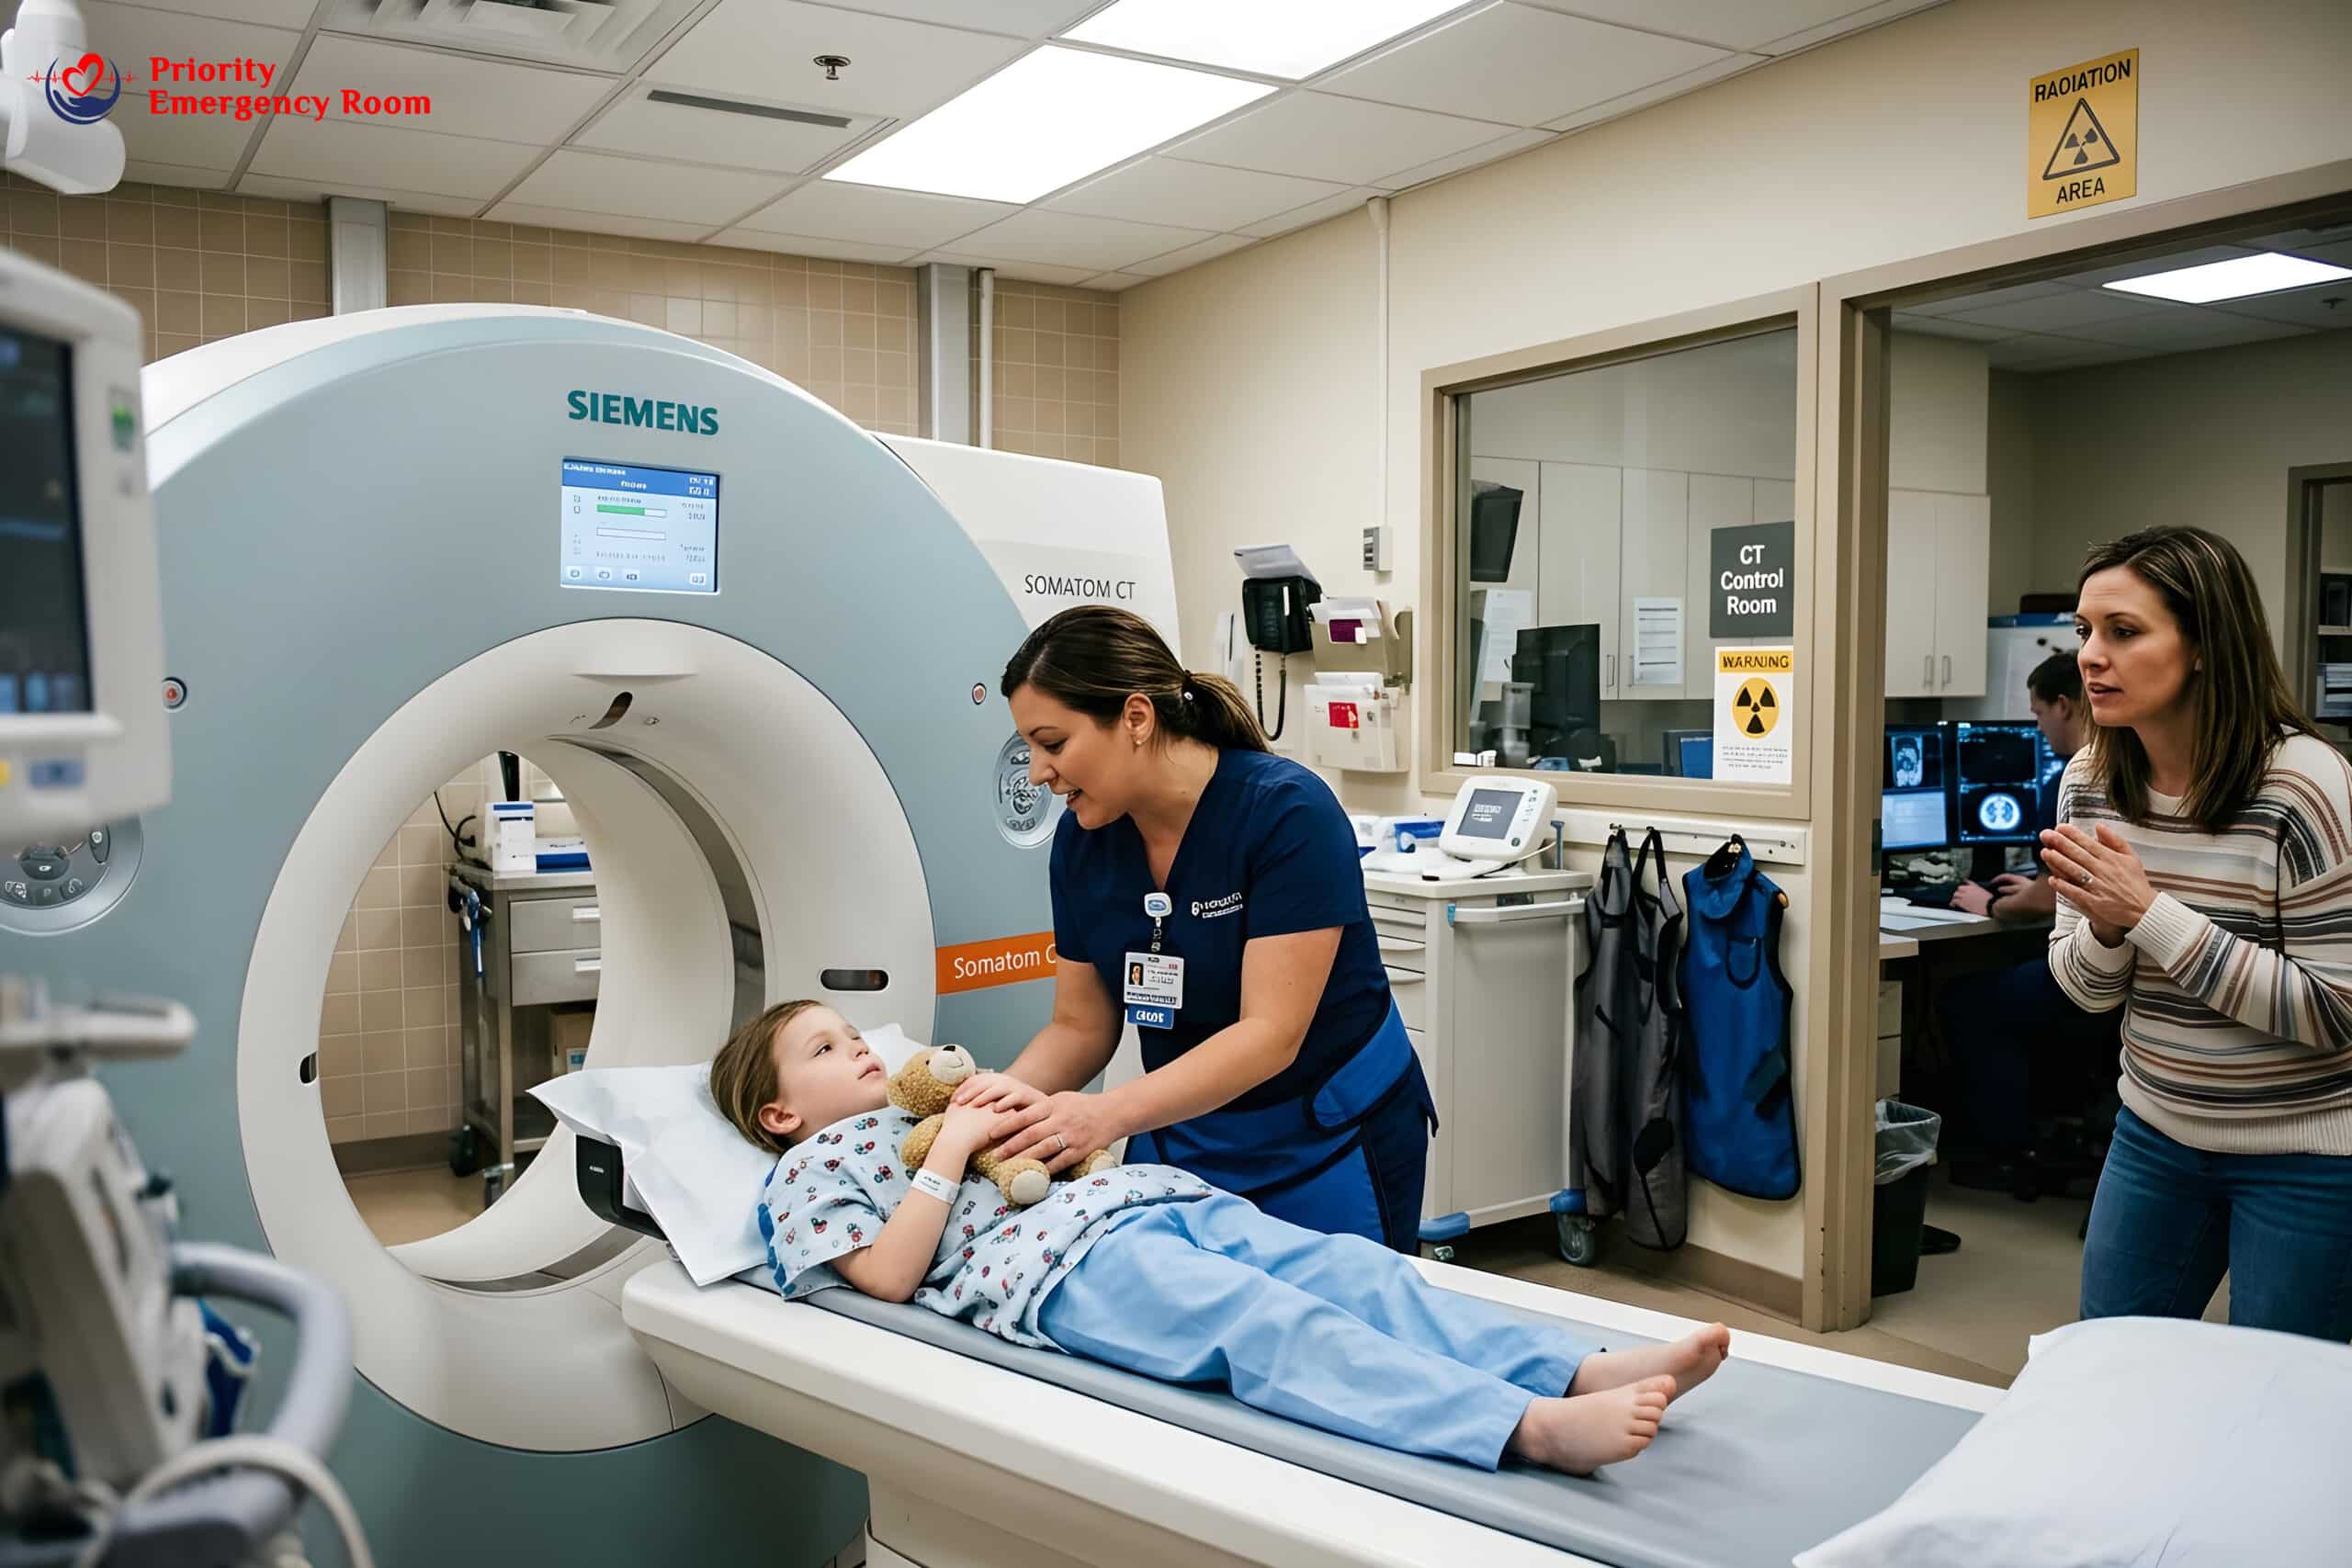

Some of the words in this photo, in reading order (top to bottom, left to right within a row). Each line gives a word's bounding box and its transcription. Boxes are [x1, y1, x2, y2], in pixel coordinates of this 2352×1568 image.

[2056, 176, 2106, 204] AREA
[567, 390, 719, 435] SIEMENS
[1739, 544, 1766, 565] CT
[1024, 574, 1111, 598] SOMATOM
[1116, 581, 1136, 600] CT
[1721, 568, 1783, 591] Control
[1727, 595, 1777, 615] Room
[1723, 655, 1790, 669] WARNING
[954, 950, 1041, 979] Somatom
